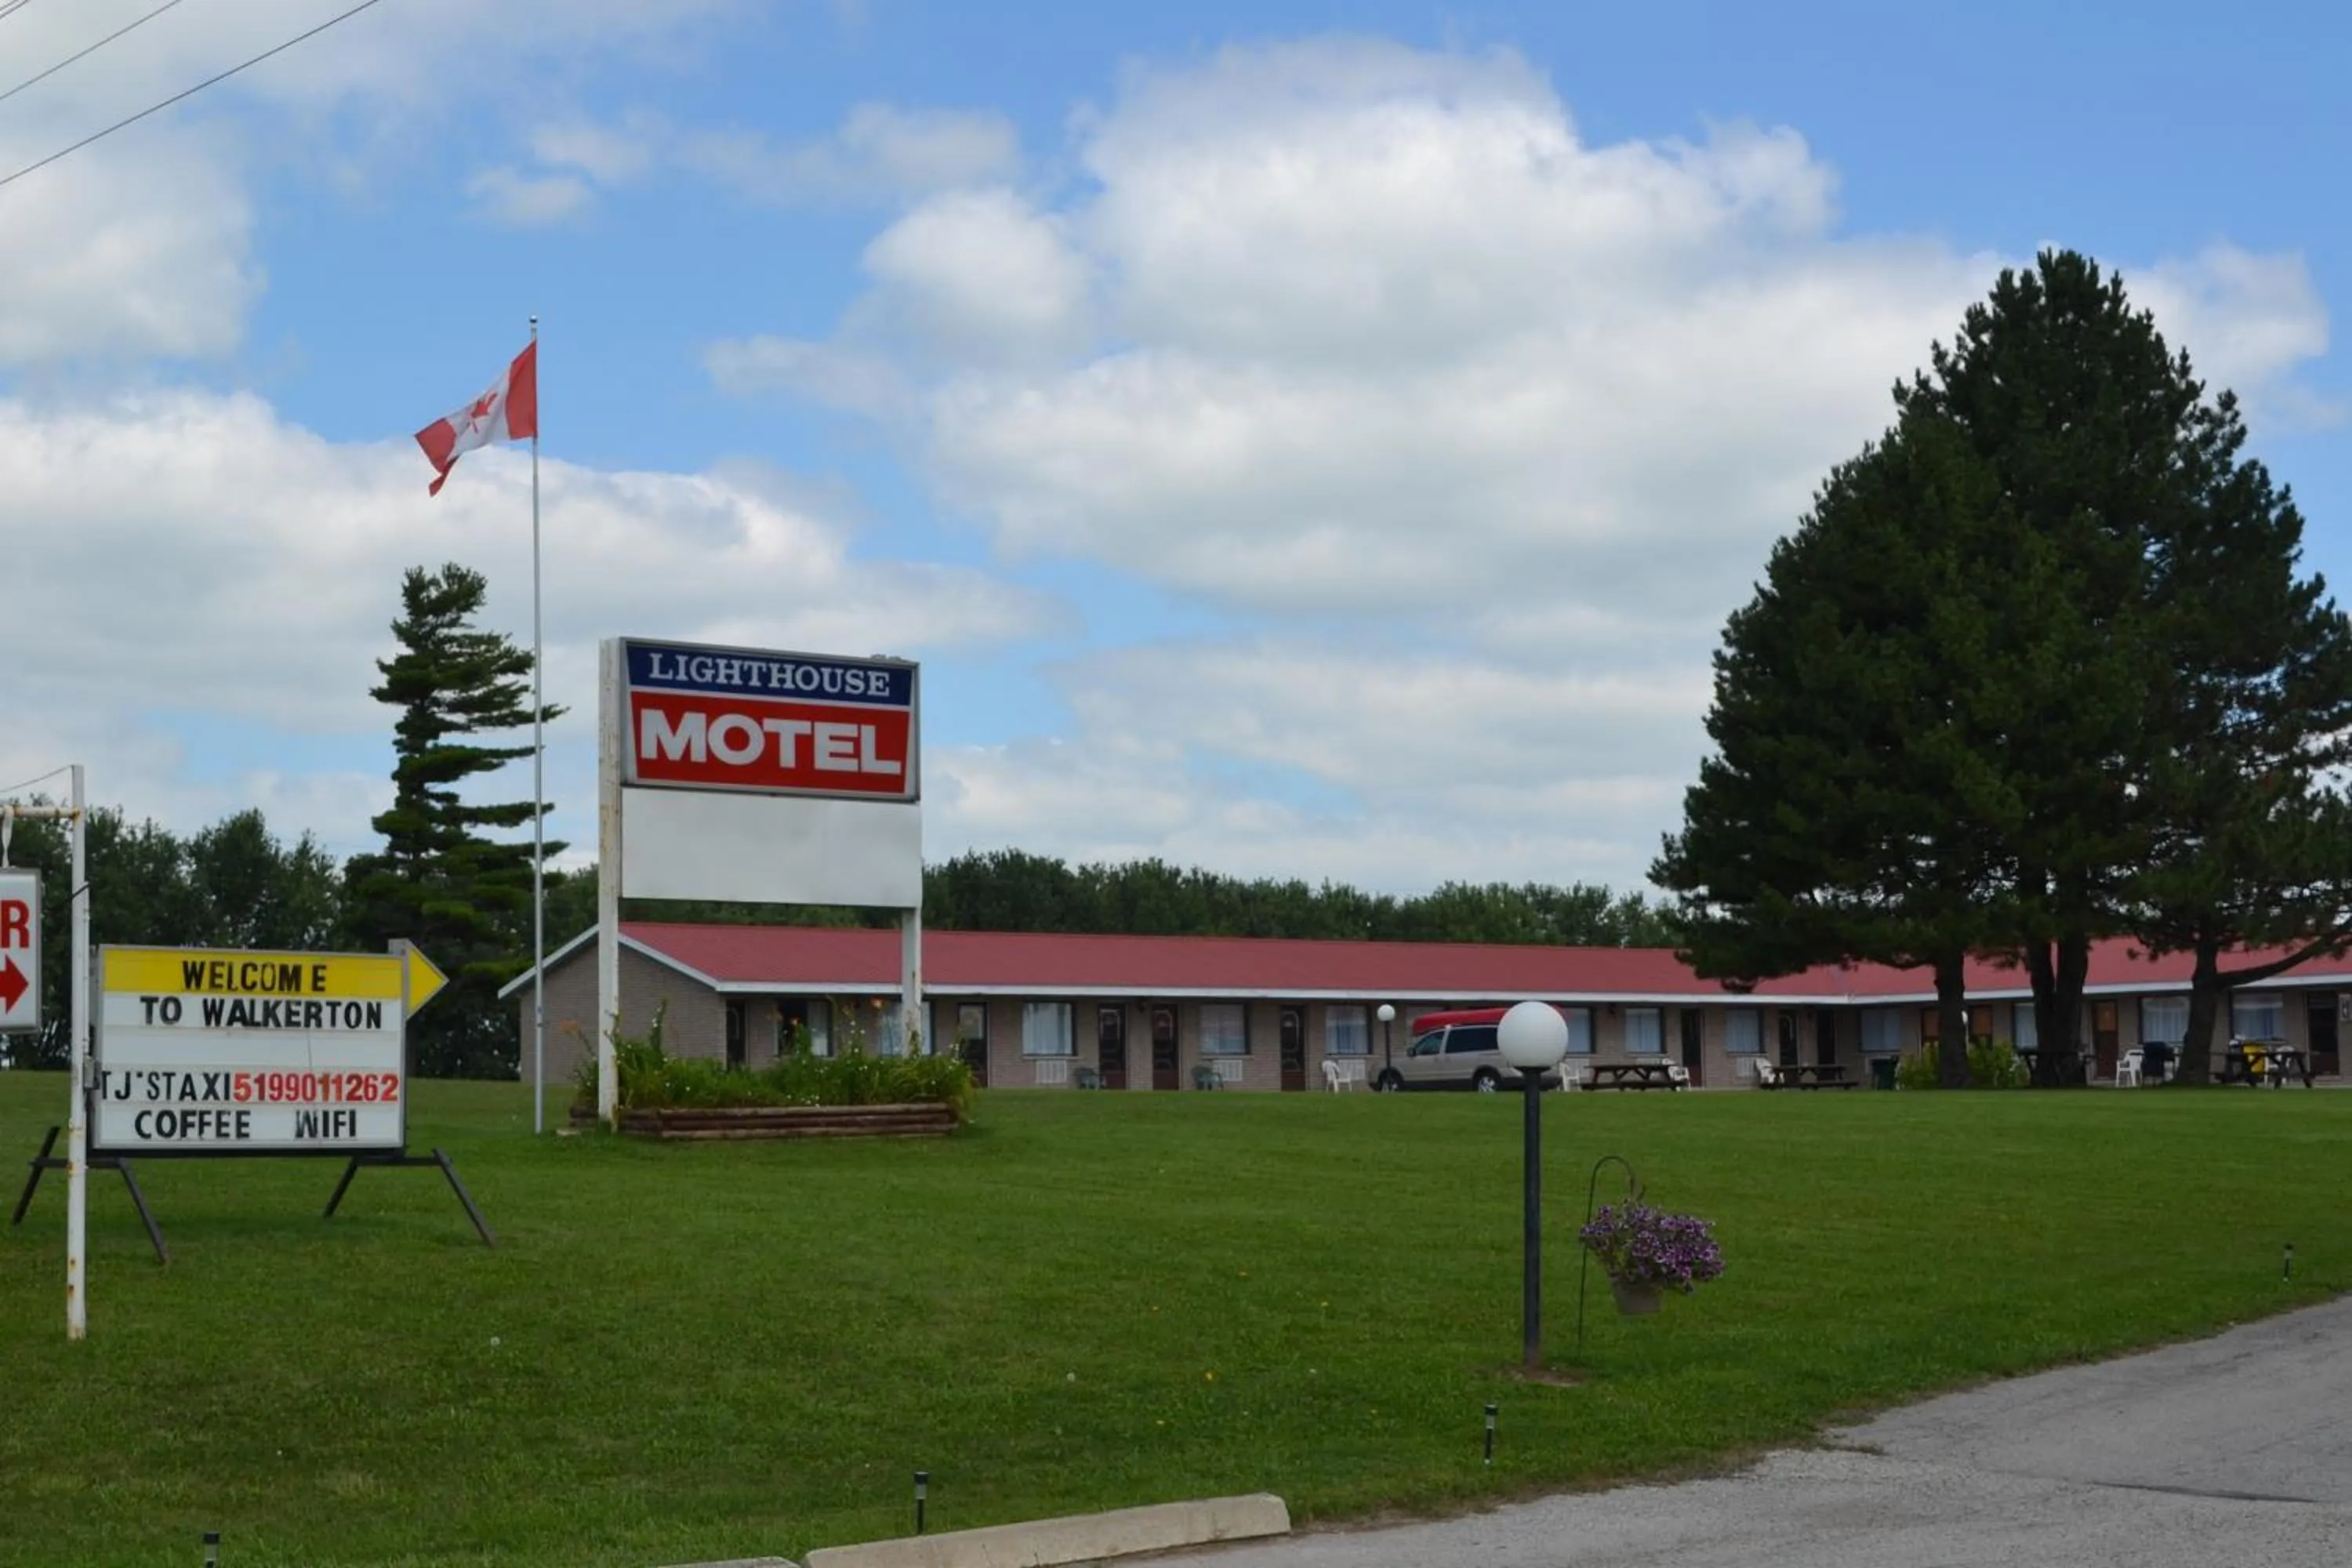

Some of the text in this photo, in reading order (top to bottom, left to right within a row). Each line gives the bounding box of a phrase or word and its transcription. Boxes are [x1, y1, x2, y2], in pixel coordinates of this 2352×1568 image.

[648, 652, 891, 697] LIGHTHOUSE
[641, 708, 902, 775] MOTEL
[182, 960, 327, 993] WELCOME
[140, 996, 382, 1029] TO WALKERTON
[134, 1109, 357, 1139] COFFEE WIFI
